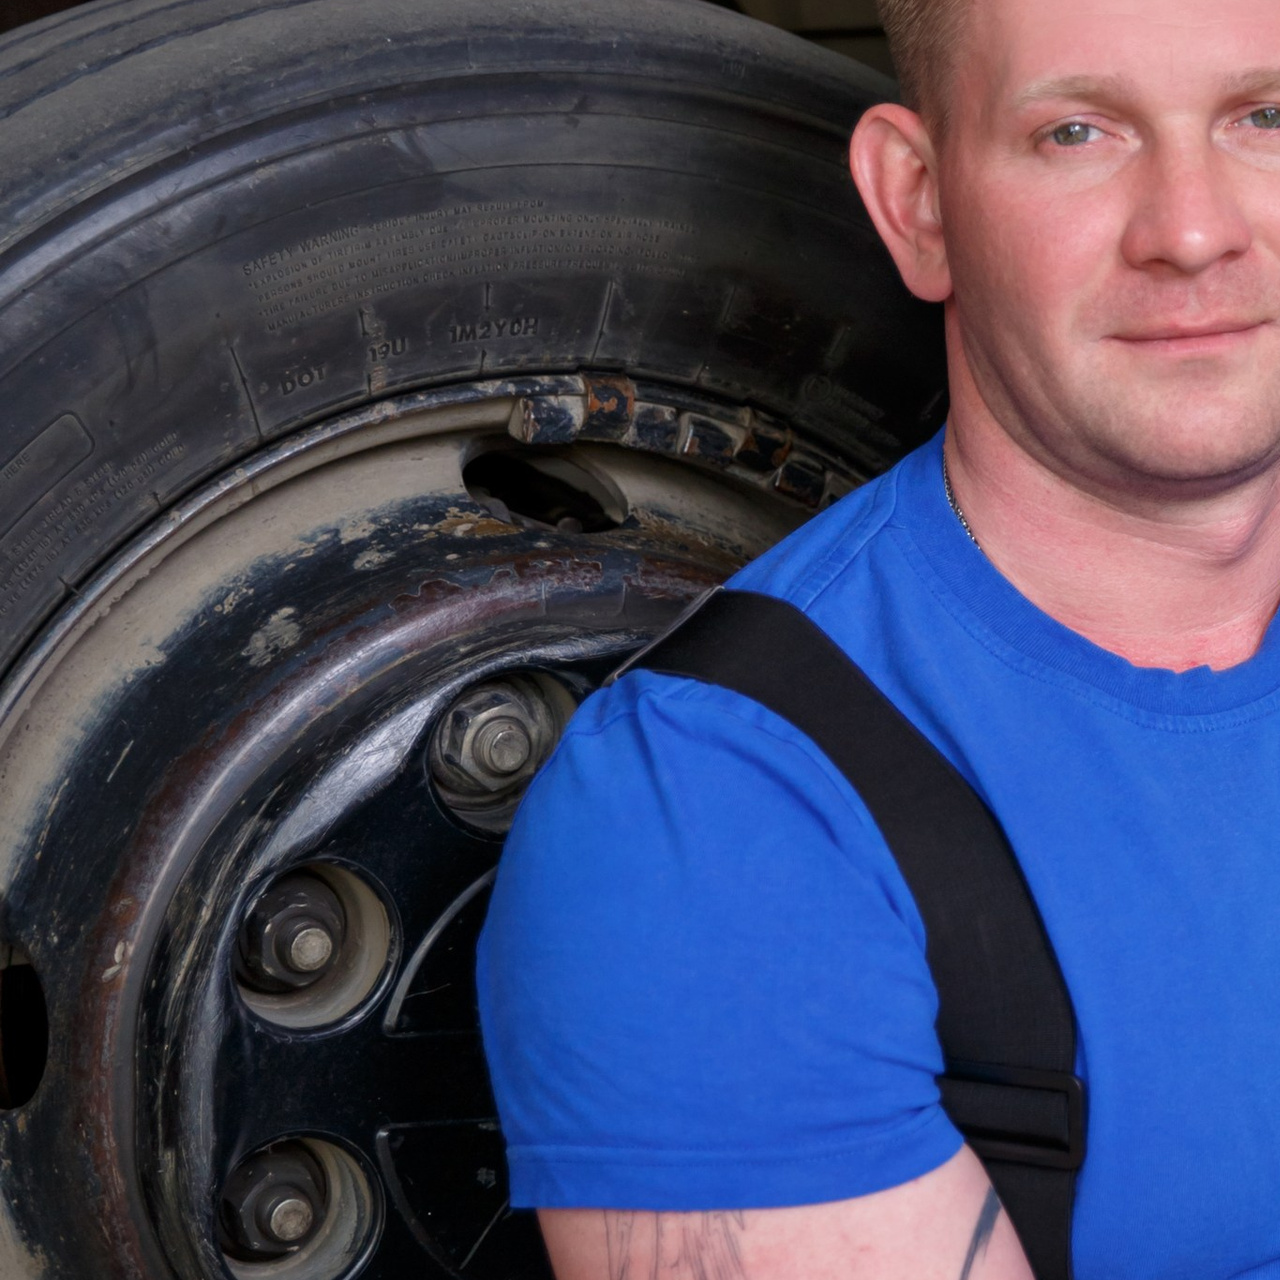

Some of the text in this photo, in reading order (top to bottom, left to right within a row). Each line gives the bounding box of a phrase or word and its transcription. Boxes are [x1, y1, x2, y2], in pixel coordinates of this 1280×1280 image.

[242, 247, 294, 277] SAFETY
[299, 226, 360, 253] WARNING
[368, 337, 407, 363] 19U
[281, 366, 326, 396] DOT
[4, 451, 31, 480] HERE
